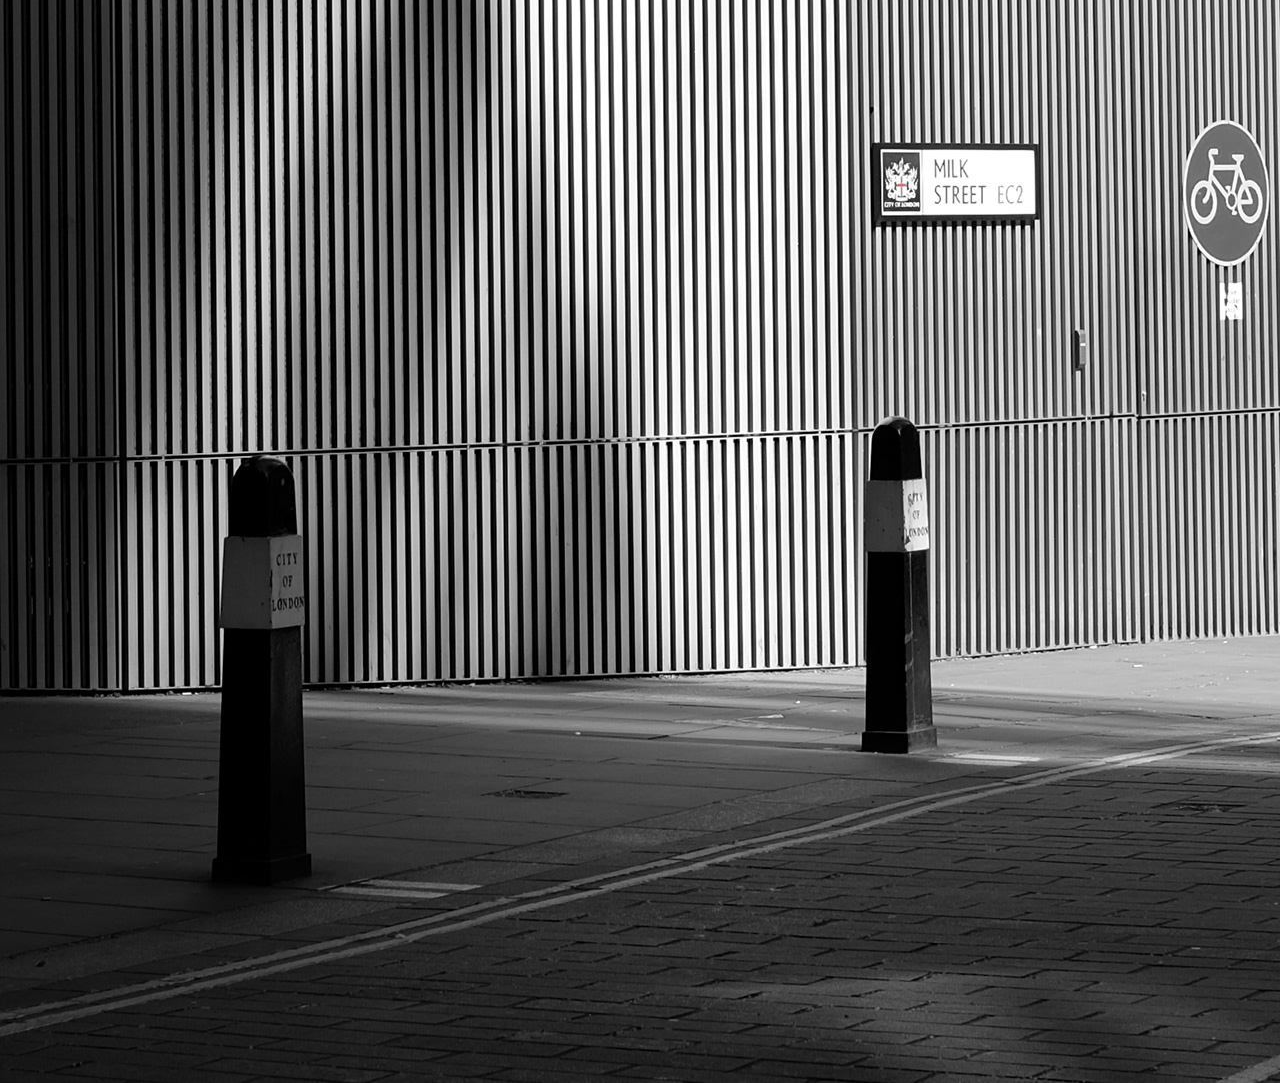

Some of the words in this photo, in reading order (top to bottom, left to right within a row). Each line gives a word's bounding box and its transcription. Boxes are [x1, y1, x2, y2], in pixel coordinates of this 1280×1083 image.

[934, 159, 969, 178] MILK
[934, 185, 986, 204] STREET
[997, 185, 1023, 204] EC2
[276, 552, 298, 566] CITY
[282, 575, 293, 587] OF
[272, 597, 304, 611] LONDON
